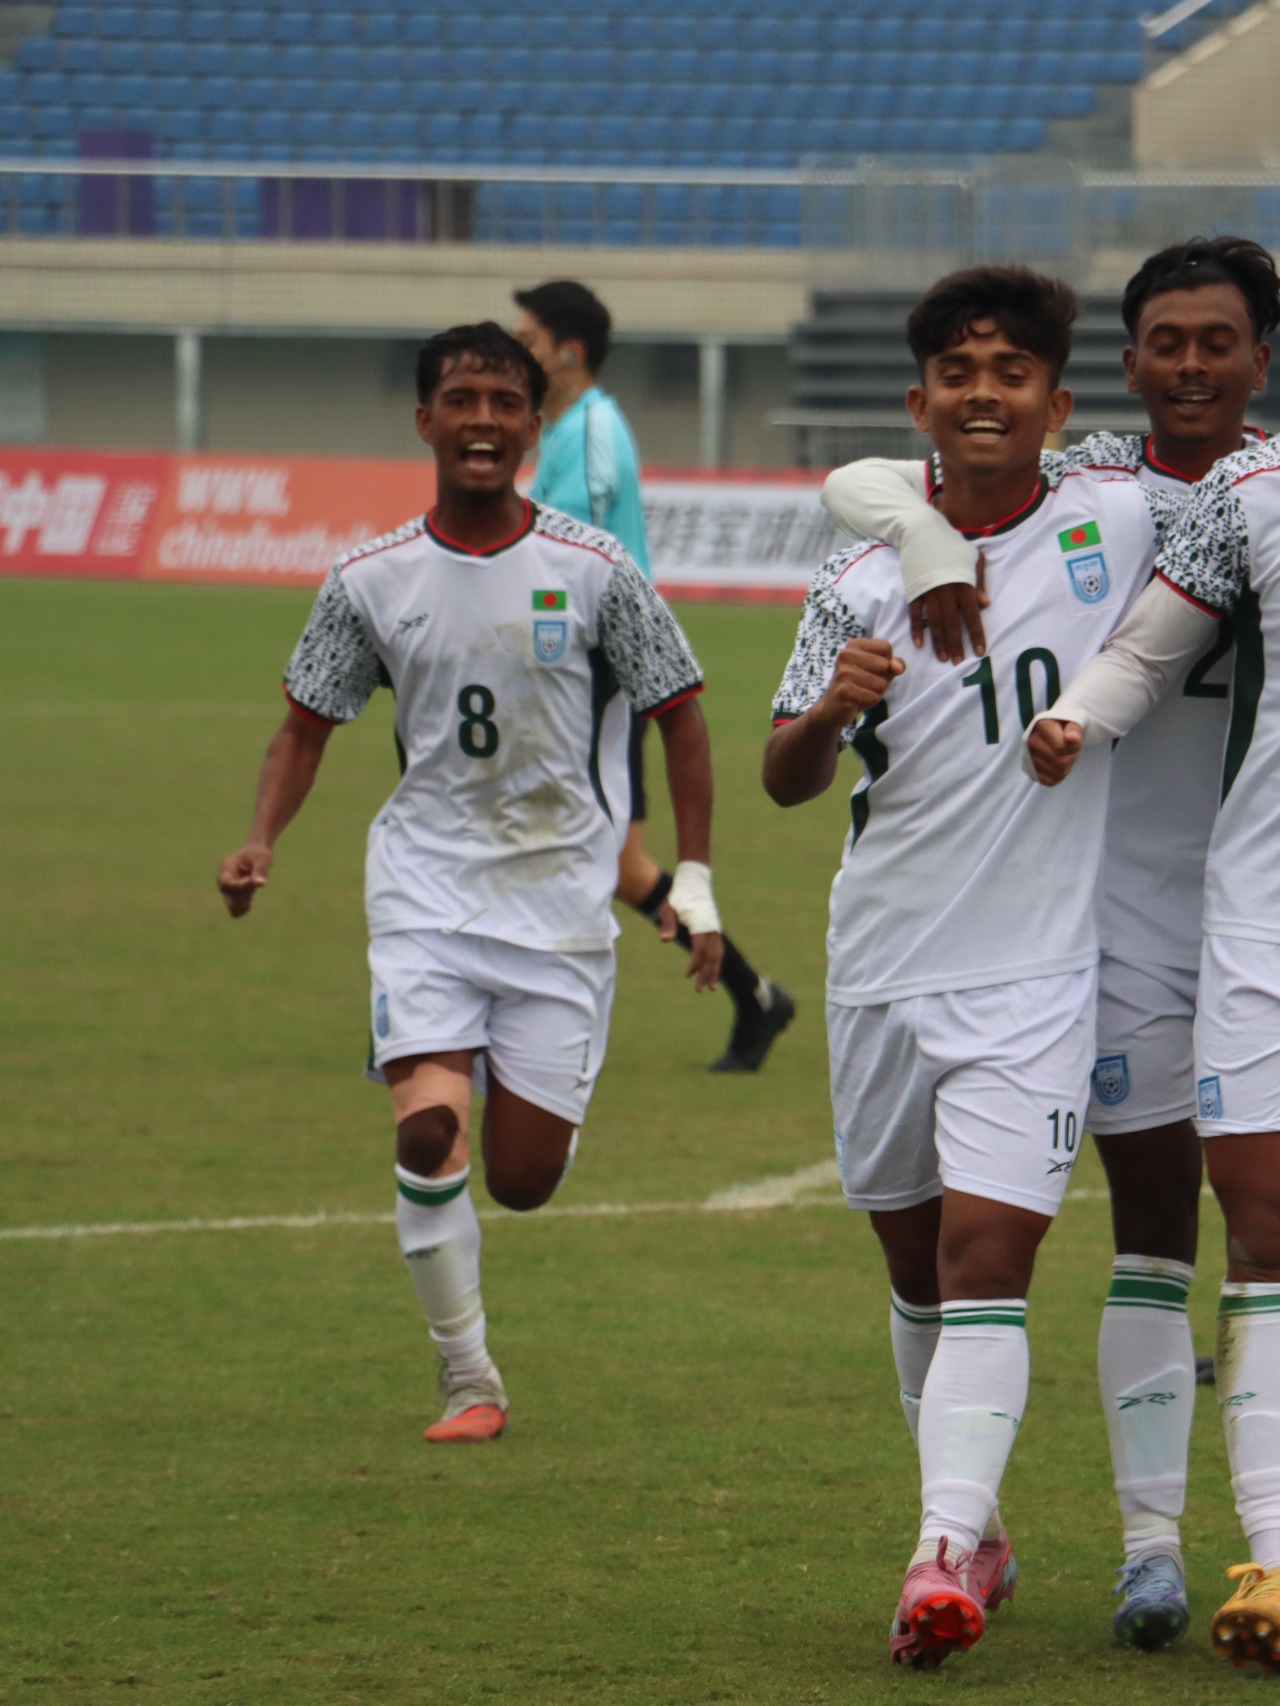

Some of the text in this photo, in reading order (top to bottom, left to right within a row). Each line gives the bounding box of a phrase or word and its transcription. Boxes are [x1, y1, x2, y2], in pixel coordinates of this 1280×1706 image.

[0, 473, 106, 555] 中国
[457, 684, 499, 758] 8
[962, 647, 1061, 745] 10
[1047, 1108, 1076, 1153] 10
